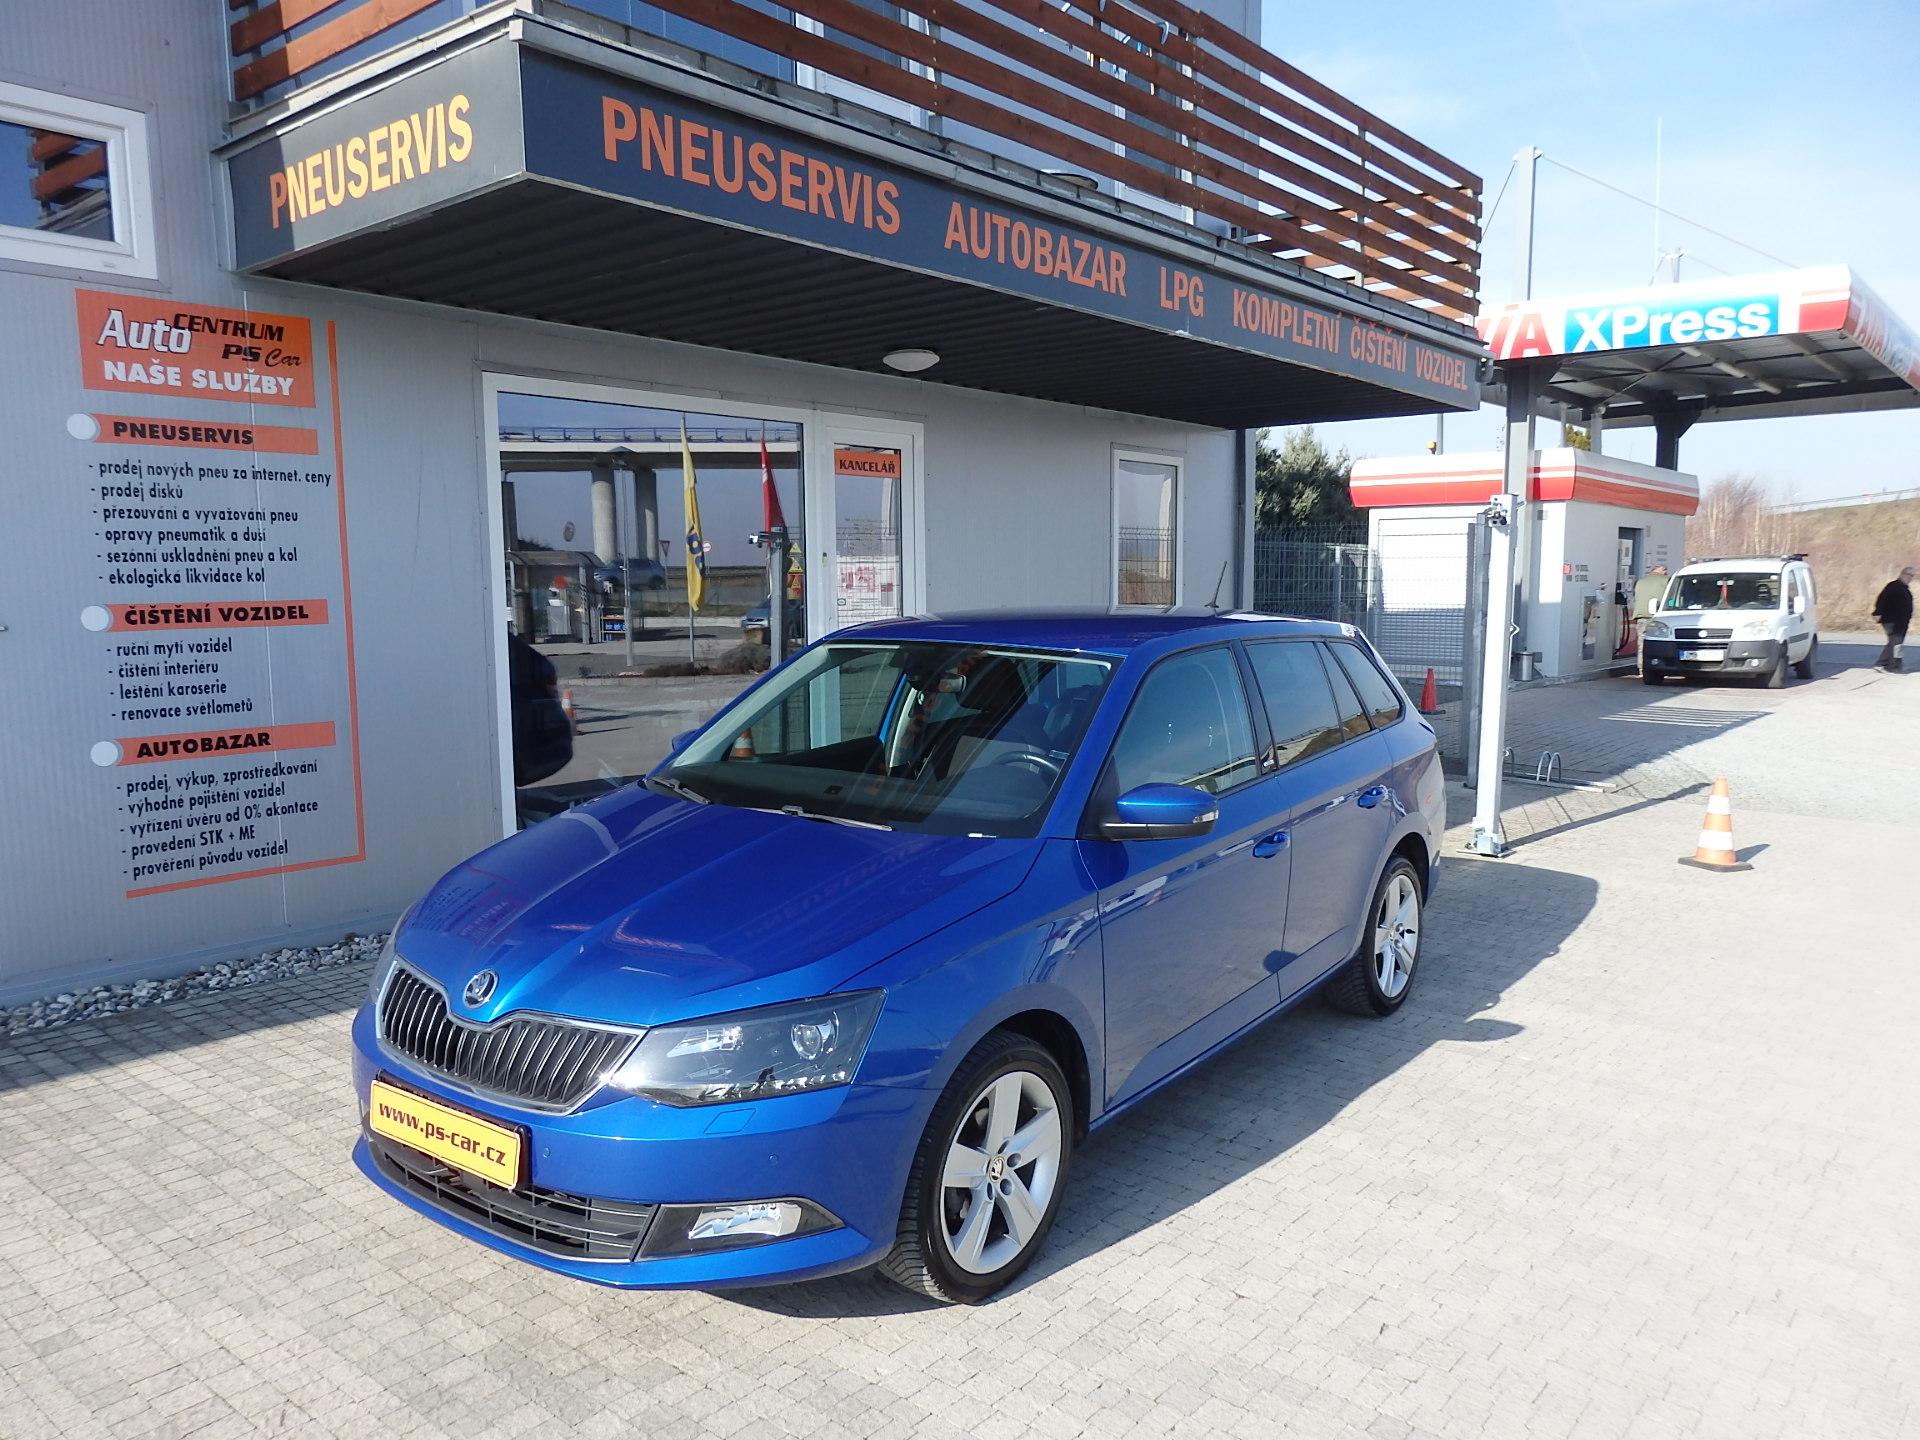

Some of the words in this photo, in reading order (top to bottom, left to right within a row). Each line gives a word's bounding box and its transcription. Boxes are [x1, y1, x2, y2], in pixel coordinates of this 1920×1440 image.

[269, 94, 474, 230] PNEUSERVIS
[602, 95, 902, 236] PNEUSERVIS
[944, 201, 1127, 298] AUTOBAZAR
[1159, 266, 1205, 318] LPG
[1232, 288, 1344, 354] KOMPLETNÍ
[1350, 315, 1409, 373] ČIŠTĚNÍ
[1415, 346, 1469, 391] VOZIDEL
[97, 308, 193, 354] Auto
[174, 313, 284, 342] CENTRUM
[1572, 302, 1772, 353] XPress
[222, 343, 261, 362] PS
[264, 348, 302, 368] Car
[103, 358, 182, 387] NAŠE
[192, 367, 294, 396] SLUŽBY
[113, 421, 254, 445] PNEUSERVIS
[99, 459, 142, 479] prodej
[147, 461, 193, 480] nových
[199, 467, 228, 481] pneu
[233, 469, 247, 480] za
[252, 465, 302, 482] internet.
[305, 472, 332, 487] ceny
[839, 459, 896, 474] KANCELÁŘ
[101, 482, 144, 501] prodej
[149, 482, 183, 498] disků
[103, 505, 177, 523] přezouvání
[182, 510, 190, 519] a
[195, 507, 266, 524] vyvažování
[270, 511, 298, 525] pneu
[105, 530, 152, 545] opravy
[158, 526, 226, 545] pneumatik
[231, 531, 238, 541] a
[243, 526, 266, 541] duší
[107, 548, 157, 563] sezónní
[161, 546, 230, 563] uskladnění
[235, 551, 264, 565] pneu
[268, 552, 275, 562] a
[280, 546, 298, 561] kol
[109, 567, 181, 588] ekologická
[186, 567, 242, 583] likvidace
[247, 567, 265, 582] kol
[125, 604, 211, 625] ČIŠTĚNÍ
[218, 605, 309, 622] VOZIDEL
[117, 642, 149, 656] ruční
[154, 640, 184, 658] mytí
[188, 636, 232, 653] vozidel
[118, 661, 160, 678] čištění
[164, 659, 218, 675] interiéru
[120, 683, 163, 699] leštění
[168, 678, 227, 697] karoserie
[121, 706, 181, 720] renovace
[186, 698, 253, 716] světlometů
[137, 732, 271, 758] AUTOBAZAR
[127, 774, 171, 797] prodej,
[176, 770, 218, 790] výkup,
[223, 760, 318, 785] zprostředkování
[128, 794, 184, 817] výhodné
[189, 788, 240, 810] pojištění
[244, 781, 285, 800] vozidel
[130, 816, 182, 838] vyřízení
[187, 813, 221, 828] úvěru
[226, 807, 240, 822] od
[244, 803, 261, 820] 0%
[266, 801, 319, 817] akontace
[131, 835, 196, 860] provedení
[200, 829, 224, 846] STK
[239, 825, 256, 840] ME
[133, 855, 195, 881] prověření
[199, 847, 243, 871] původu
[247, 839, 289, 859] vozidel
[379, 1103, 506, 1167] www.ps-car.cz
